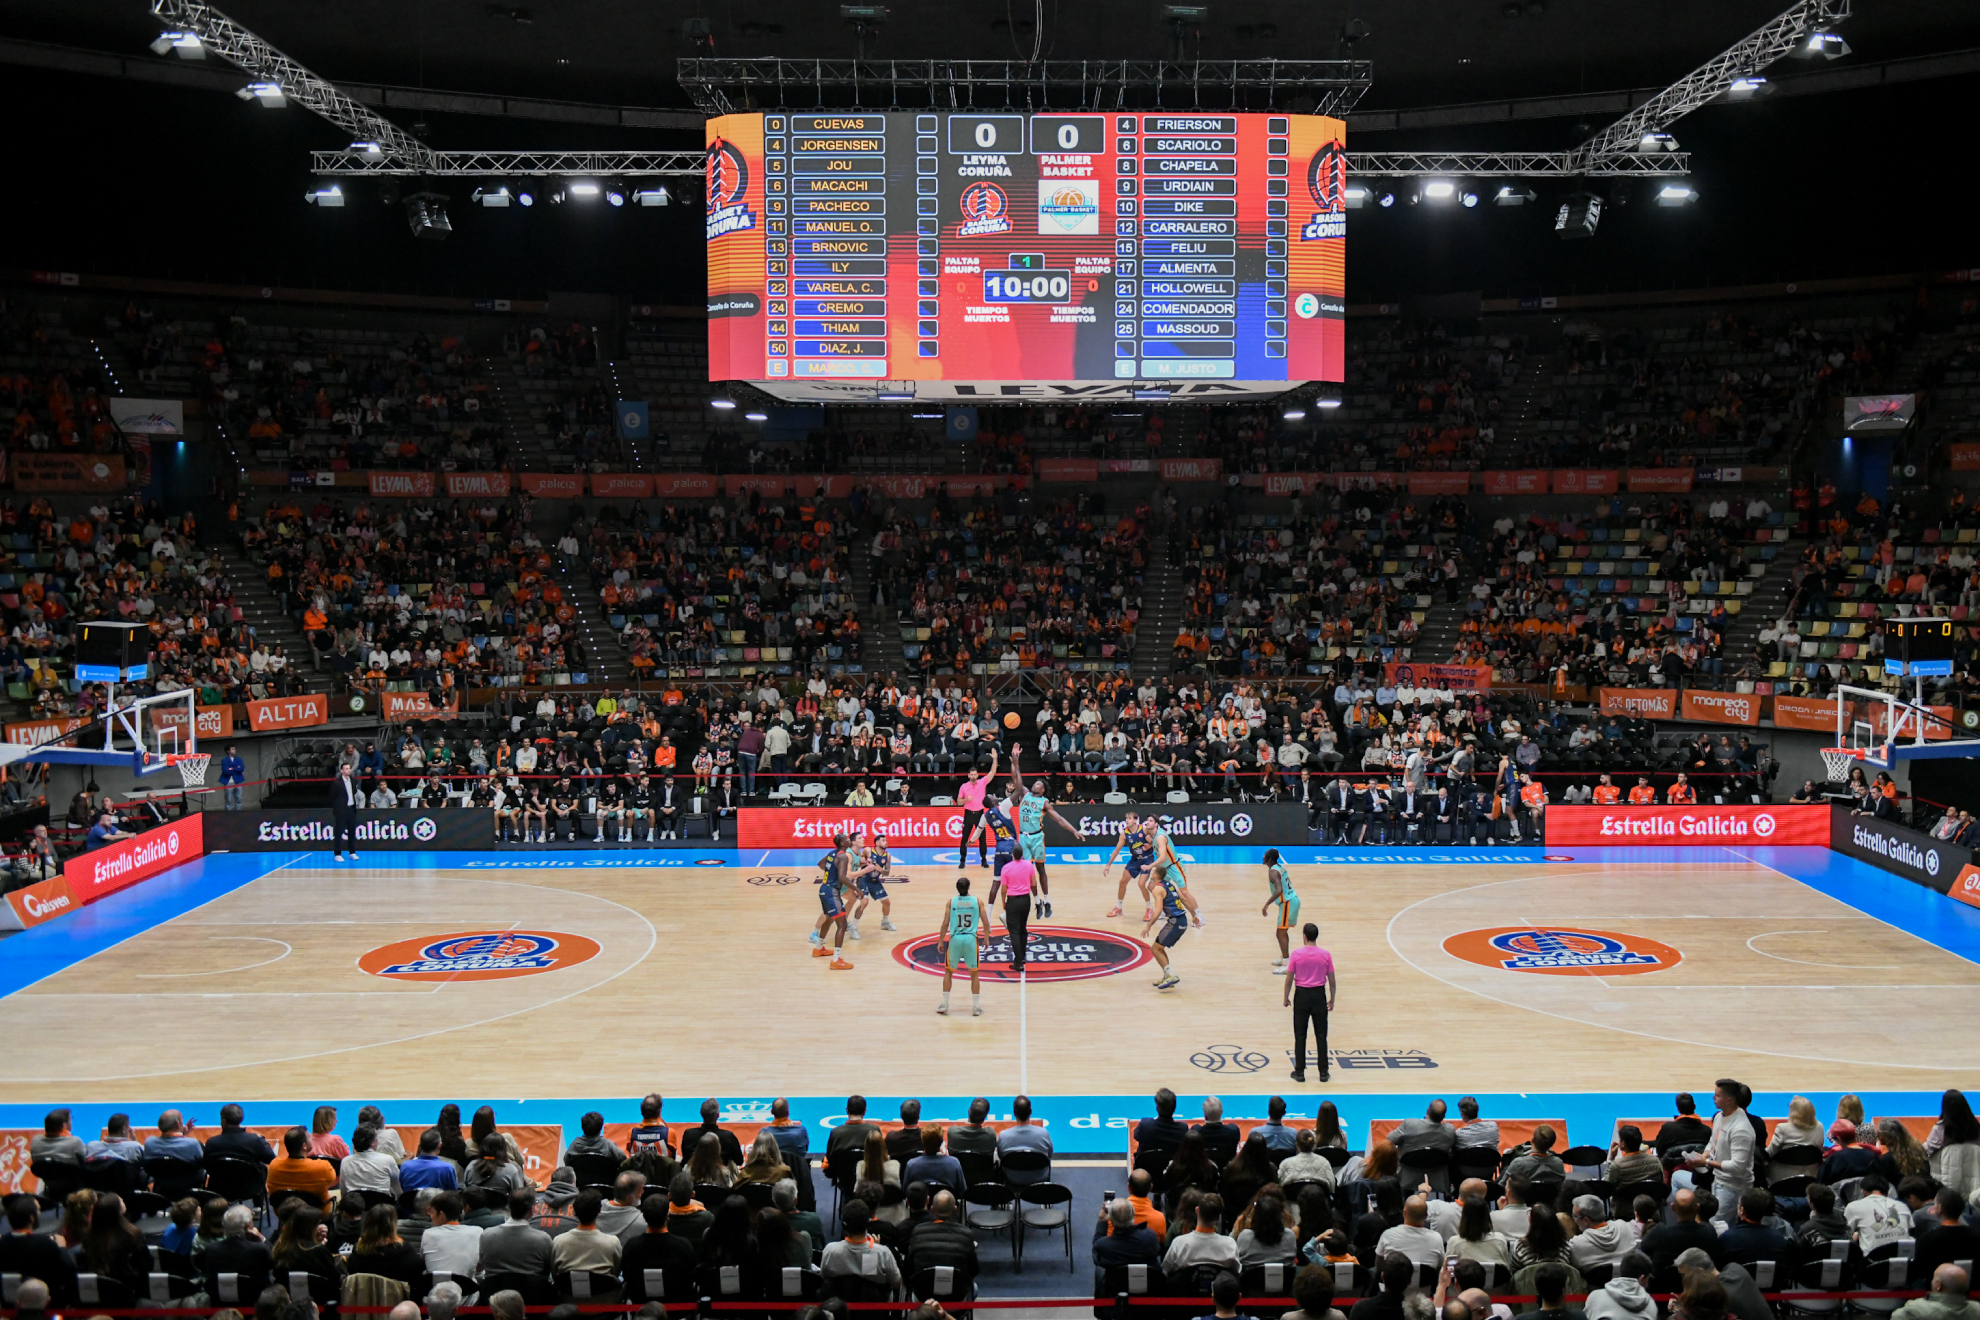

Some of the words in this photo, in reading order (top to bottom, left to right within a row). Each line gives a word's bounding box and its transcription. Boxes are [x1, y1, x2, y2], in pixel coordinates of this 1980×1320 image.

[773, 120, 779, 129] 0
[814, 120, 864, 129] CUEVAS
[1123, 121, 1129, 129] 4
[1157, 120, 1221, 130] FRIERSON
[975, 124, 996, 147] 0
[1058, 126, 1078, 148] 0
[773, 141, 780, 150] 4
[801, 141, 878, 151] JORGENSEN
[1123, 141, 1130, 150] 6
[1157, 141, 1221, 150] SCARIOLO
[963, 156, 1006, 164] LEYMA
[1042, 156, 1091, 164] PALMER
[774, 162, 780, 170] 5
[827, 161, 852, 170] JOU
[1123, 162, 1129, 171] 8
[1160, 161, 1218, 171] CHAPELA
[959, 166, 1012, 176] CORUÑA
[1043, 167, 1093, 176] BASKET
[774, 182, 780, 191] 6
[811, 181, 868, 190] MACACHI
[1123, 182, 1130, 191] 9
[1164, 182, 1214, 191] URDIAIN
[774, 202, 781, 211] 9
[810, 202, 869, 211] PACHECO
[1120, 203, 1133, 212] 10
[1175, 203, 1203, 212] DIKE
[771, 222, 782, 231] 11
[806, 222, 857, 231] MANUEL
[860, 222, 872, 232] O.
[1120, 223, 1133, 232] 12
[1150, 223, 1226, 233] CARRALERO
[771, 243, 784, 252] 13
[812, 243, 868, 252] BRNOVIC
[1119, 243, 1132, 252] 15
[1171, 243, 1206, 253] FELIU
[771, 263, 784, 272] 21
[832, 263, 849, 272] ILY
[1120, 264, 1132, 272] 17
[1159, 264, 1217, 273] ALMENTA
[771, 283, 784, 292] 22
[807, 283, 856, 294] VARELA,
[861, 283, 873, 292] C.
[957, 283, 966, 292] 0
[987, 278, 1067, 297] 10:00
[1088, 280, 1098, 291] 0
[1119, 284, 1132, 293] 21
[1152, 284, 1226, 293] HOLLOWELL
[730, 301, 754, 309] Coruña
[771, 303, 784, 312] 24
[818, 303, 863, 312] CREMO
[1119, 304, 1132, 314] 24
[1144, 304, 1233, 314] COMENDADOR
[771, 324, 785, 333] 44
[821, 324, 859, 332] THIAM
[1119, 325, 1132, 334] 25
[1157, 324, 1219, 334] MASSOUD
[771, 344, 785, 353] 50
[819, 344, 850, 354] DIAZ,
[854, 344, 863, 353] J.
[775, 364, 782, 372] E
[1122, 365, 1128, 373] E
[1165, 462, 1201, 479] LEYMA
[372, 475, 414, 494] LEYMA
[450, 475, 491, 494] LEYMA
[533, 479, 575, 492] galicia
[603, 479, 645, 492] galicia
[667, 479, 708, 492] galicia
[1268, 476, 1306, 493] LEYMA
[354, 699, 361, 709] 2
[1693, 695, 1749, 709] marineda
[258, 702, 319, 724] ALTIA
[1725, 707, 1749, 721] city
[1879, 710, 1942, 732] ALTA
[1967, 714, 1974, 725] 5
[198, 720, 221, 734] city
[11, 725, 66, 747] LEYMA
[793, 817, 867, 838] Estrella
[871, 816, 940, 837] Galicia
[1158, 814, 1226, 836] Galicia
[1600, 816, 1674, 836] Estrella
[1679, 815, 1747, 836] Galicia
[258, 820, 334, 841] Estrella
[337, 820, 409, 841] alicia
[996, 826, 1011, 838] 21
[1853, 824, 1887, 857] Estrella
[1888, 835, 1923, 876] Galicia
[94, 852, 132, 884] Estrella
[133, 839, 166, 868] Galicia
[582, 859, 684, 867] Galicia
[957, 914, 972, 928] 15
[1069, 1114, 1129, 1129] da
[540, 1217, 561, 1228] DRY
